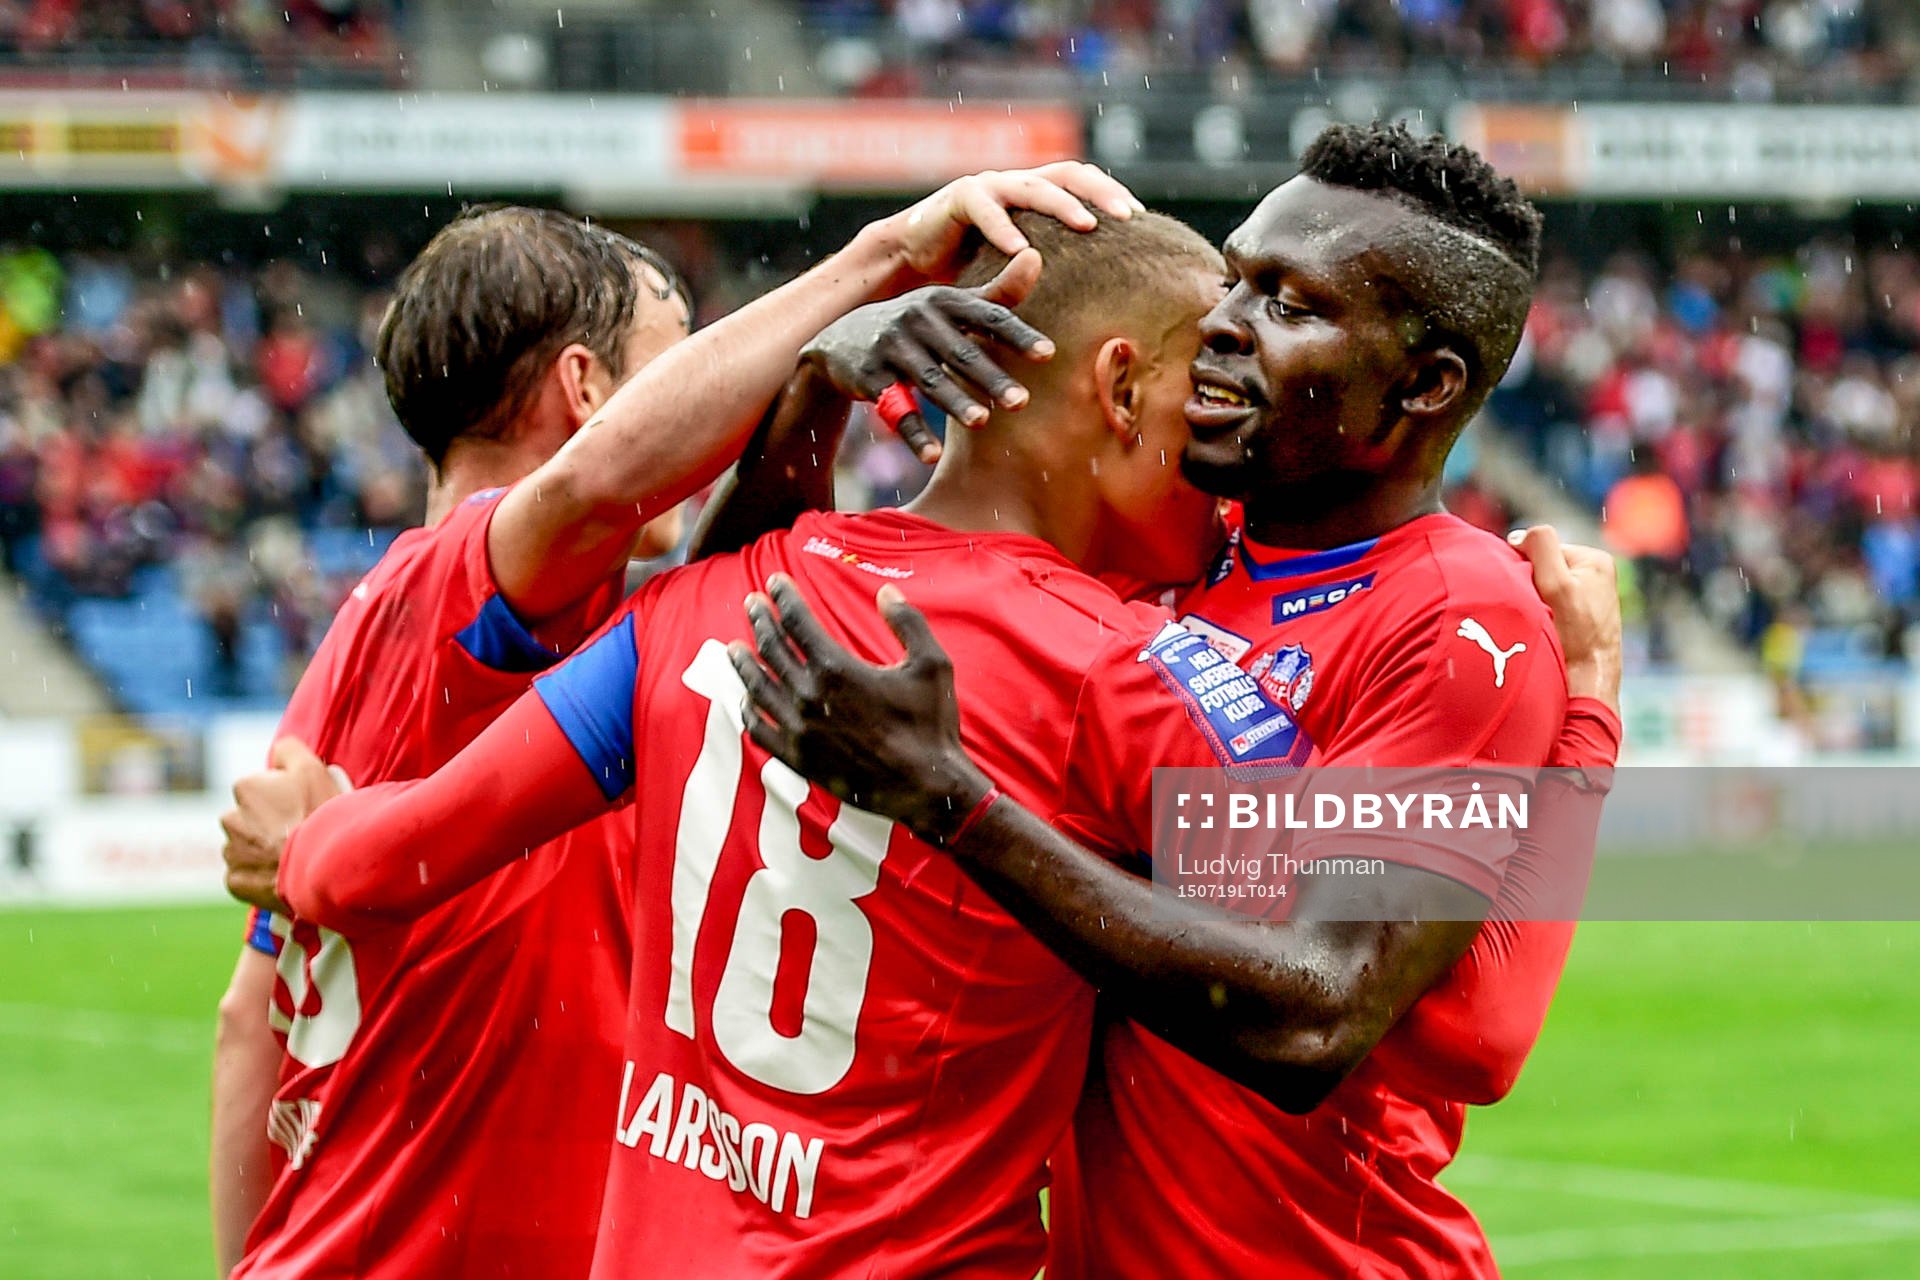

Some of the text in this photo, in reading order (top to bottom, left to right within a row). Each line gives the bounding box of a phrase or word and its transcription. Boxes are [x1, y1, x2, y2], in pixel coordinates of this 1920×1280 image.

[1188, 662, 1246, 695] SVERIGE
[664, 638, 894, 1094] 18
[616, 1060, 825, 1219] LARSSON
